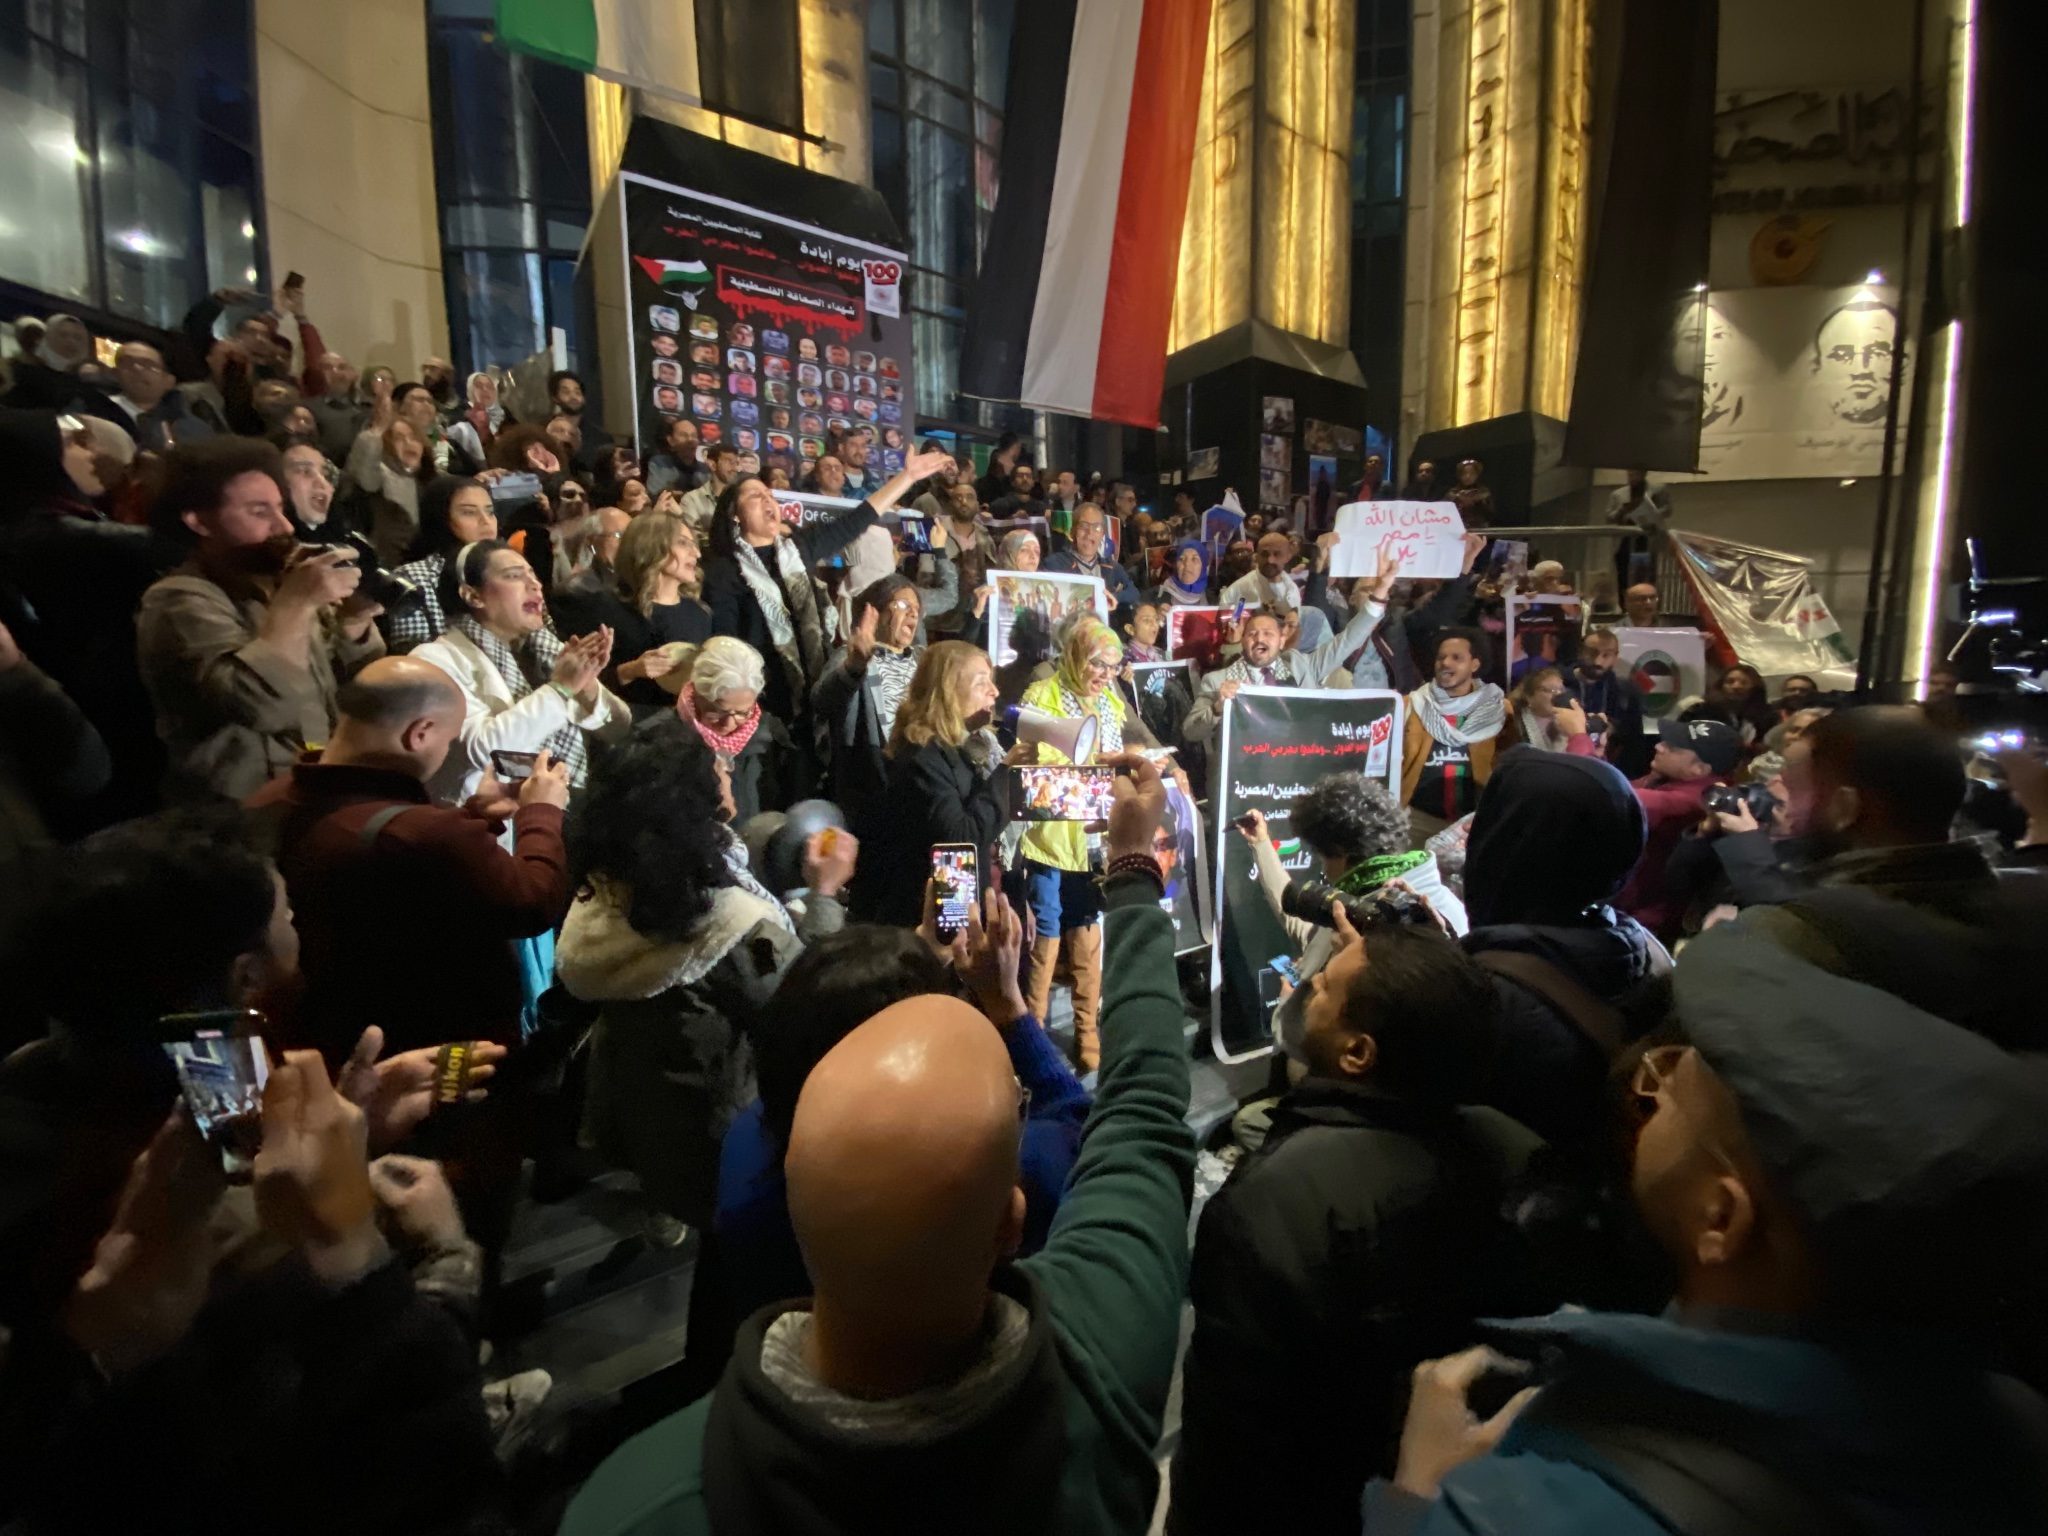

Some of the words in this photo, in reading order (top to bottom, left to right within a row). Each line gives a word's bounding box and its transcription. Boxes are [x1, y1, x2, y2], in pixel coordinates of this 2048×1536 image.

[800, 240, 833, 265] إبادة
[836, 255, 861, 272] يوم
[863, 262, 899, 281] 100
[729, 275, 785, 297] الفلسطينية
[1364, 504, 1394, 526] الله
[1331, 722, 1354, 740] إبادة
[1355, 724, 1370, 740] يوم
[1234, 780, 1275, 799] المصرية
